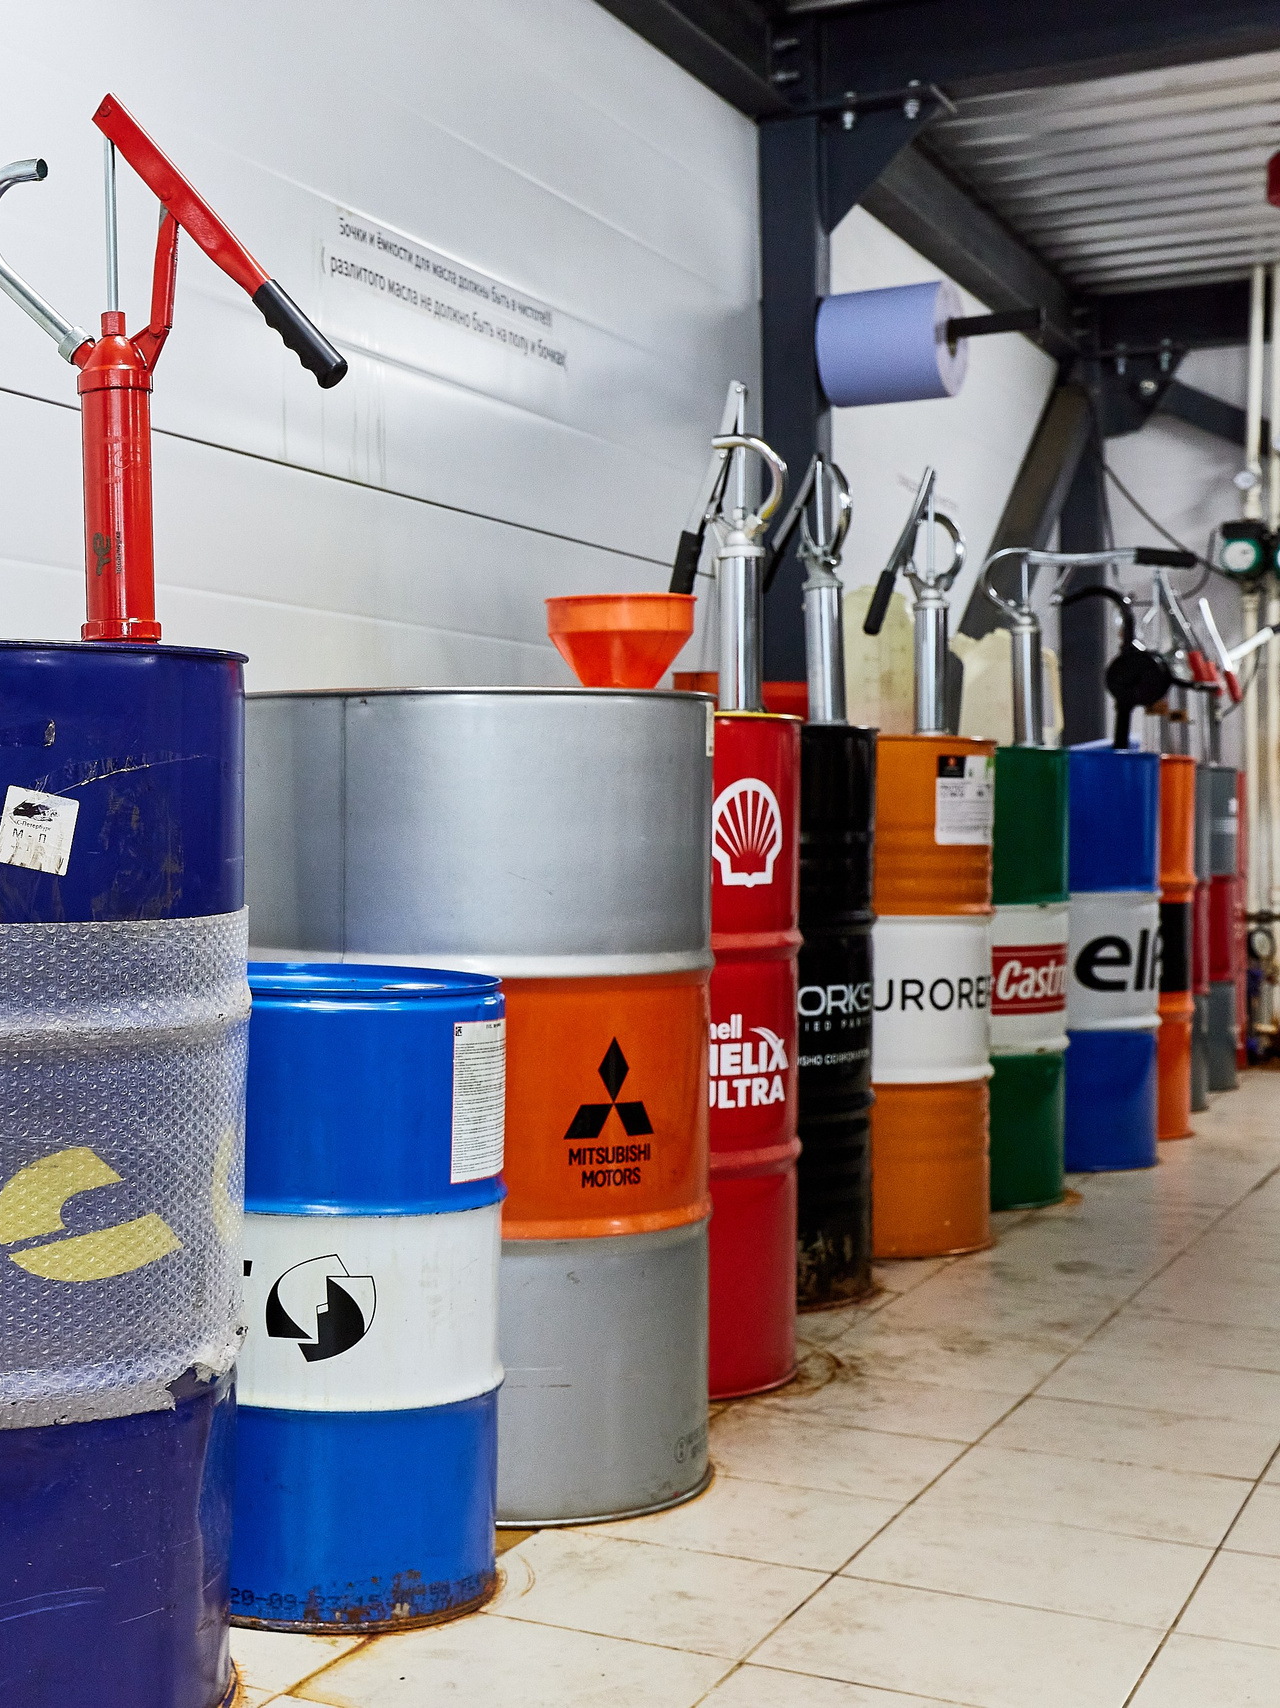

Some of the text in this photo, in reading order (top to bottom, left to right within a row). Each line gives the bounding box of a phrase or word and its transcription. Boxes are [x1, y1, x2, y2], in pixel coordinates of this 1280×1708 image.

[338, 217, 367, 243] Бочки
[388, 278, 418, 306] масла
[420, 294, 433, 313] не
[434, 299, 470, 329] должно
[472, 311, 494, 338] быть
[568, 1143, 651, 1166] MITSUBISHI
[581, 1166, 642, 1189] MOTORS
